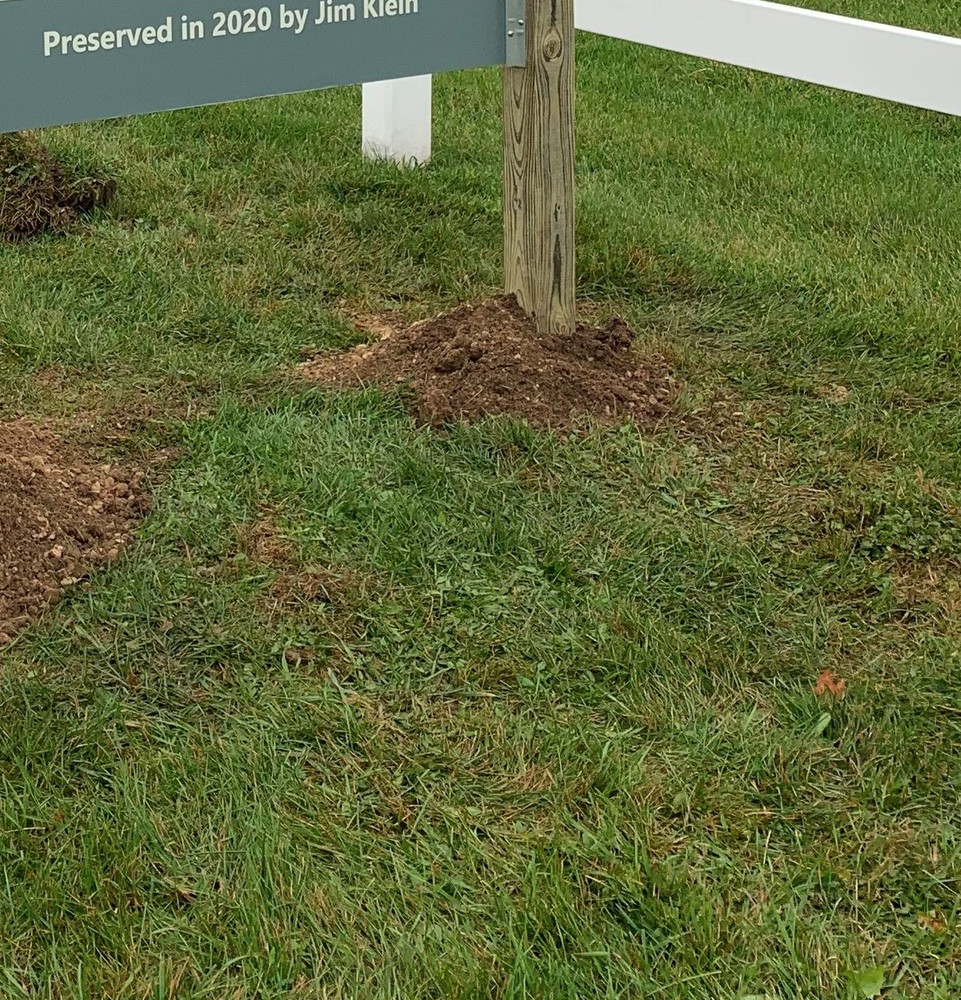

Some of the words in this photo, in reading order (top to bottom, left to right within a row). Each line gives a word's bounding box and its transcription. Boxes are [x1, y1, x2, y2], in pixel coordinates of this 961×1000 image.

[42, 17, 174, 57] Preserved
[181, 14, 205, 40] in
[211, 7, 272, 37] 2020
[278, 3, 307, 34] by
